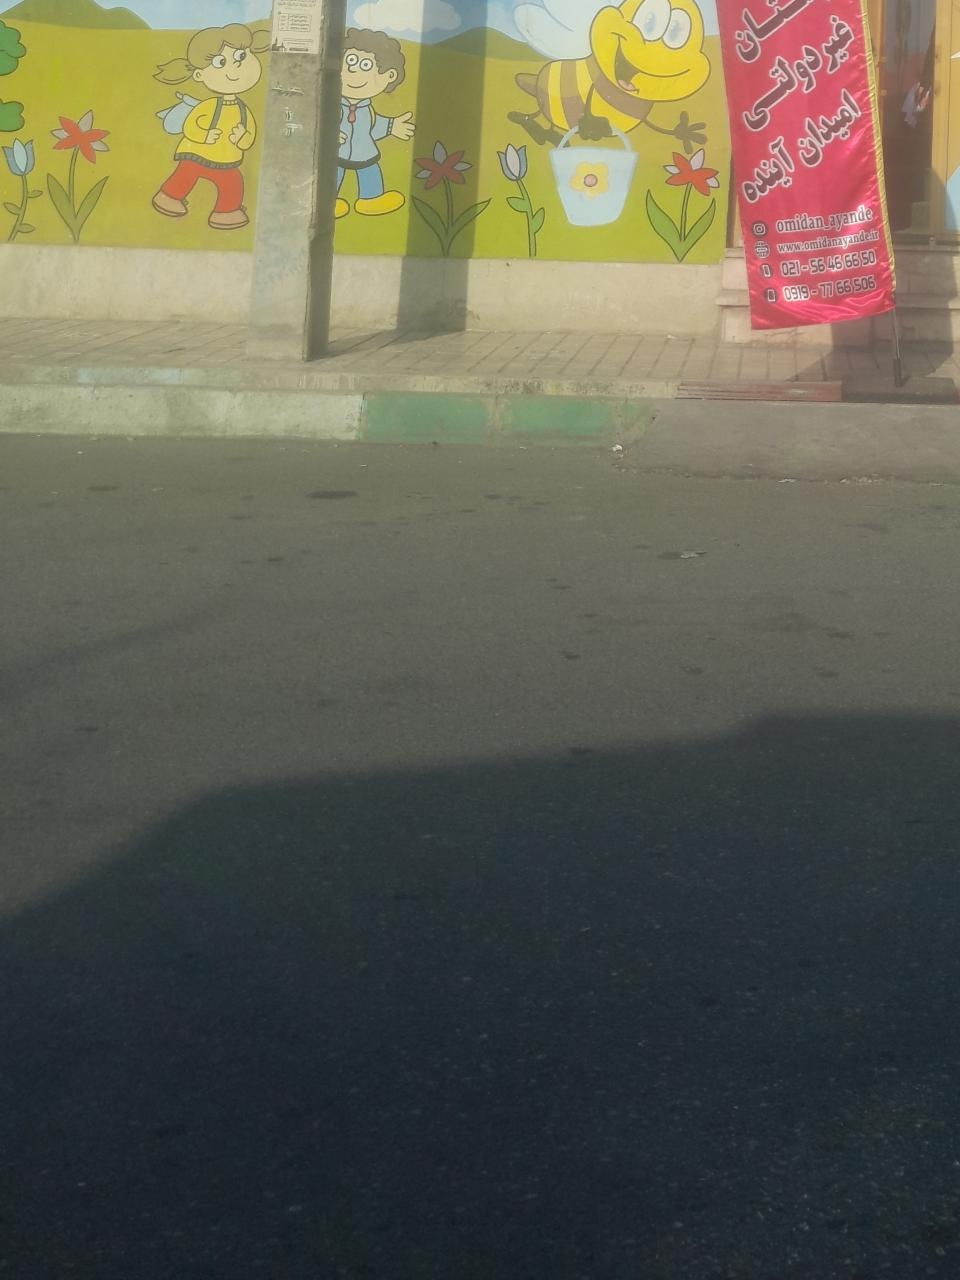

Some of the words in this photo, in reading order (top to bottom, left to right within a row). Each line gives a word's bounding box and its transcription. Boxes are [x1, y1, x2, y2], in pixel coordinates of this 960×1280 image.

[798, 88, 862, 167] امیدان
[740, 135, 795, 203] آینده
[776, 205, 873, 232] omidan_ayande
[777, 229, 880, 254] www.omidanayande.ir
